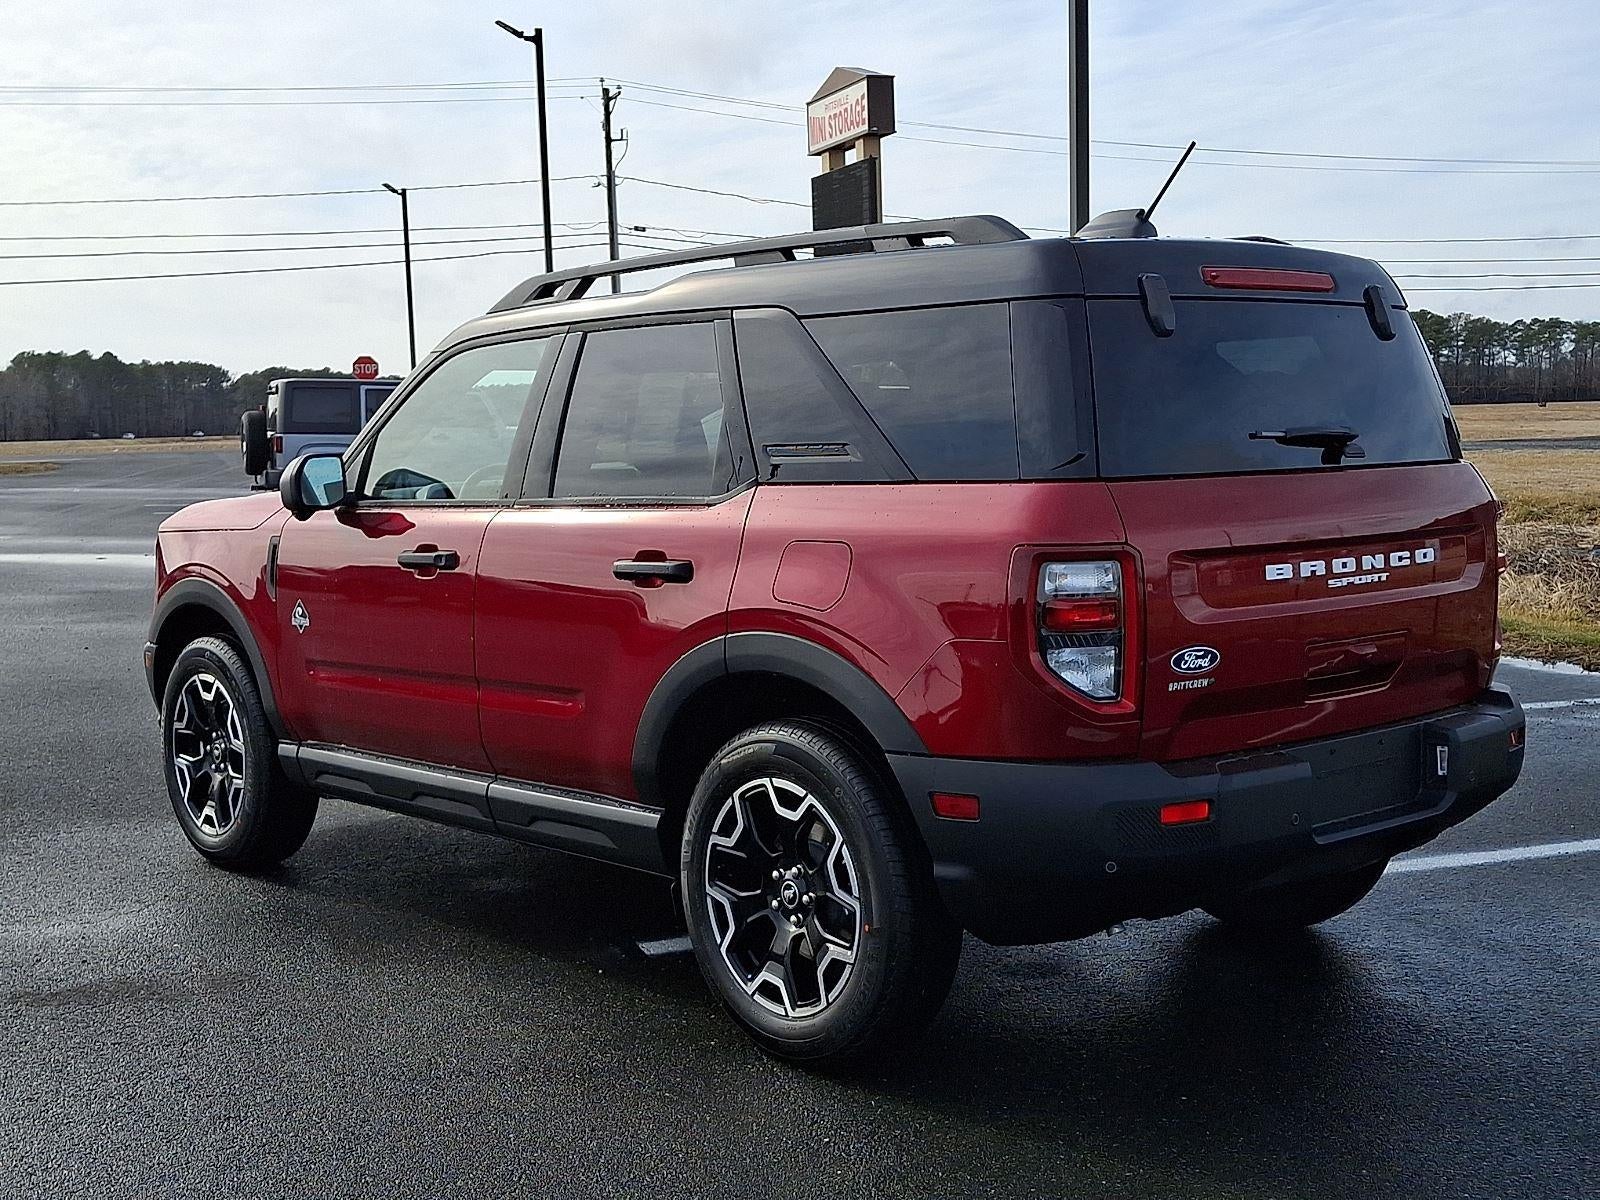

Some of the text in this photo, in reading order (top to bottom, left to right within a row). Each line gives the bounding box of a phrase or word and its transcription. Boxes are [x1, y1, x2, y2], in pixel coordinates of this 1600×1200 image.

[824, 95, 850, 112] PITTSVILLE
[810, 93, 866, 146] MINI STORAGE
[354, 363, 377, 374] STOP
[1265, 547, 1435, 580] BRONCO
[1327, 572, 1390, 588] SPORT
[1181, 651, 1212, 669] Ford
